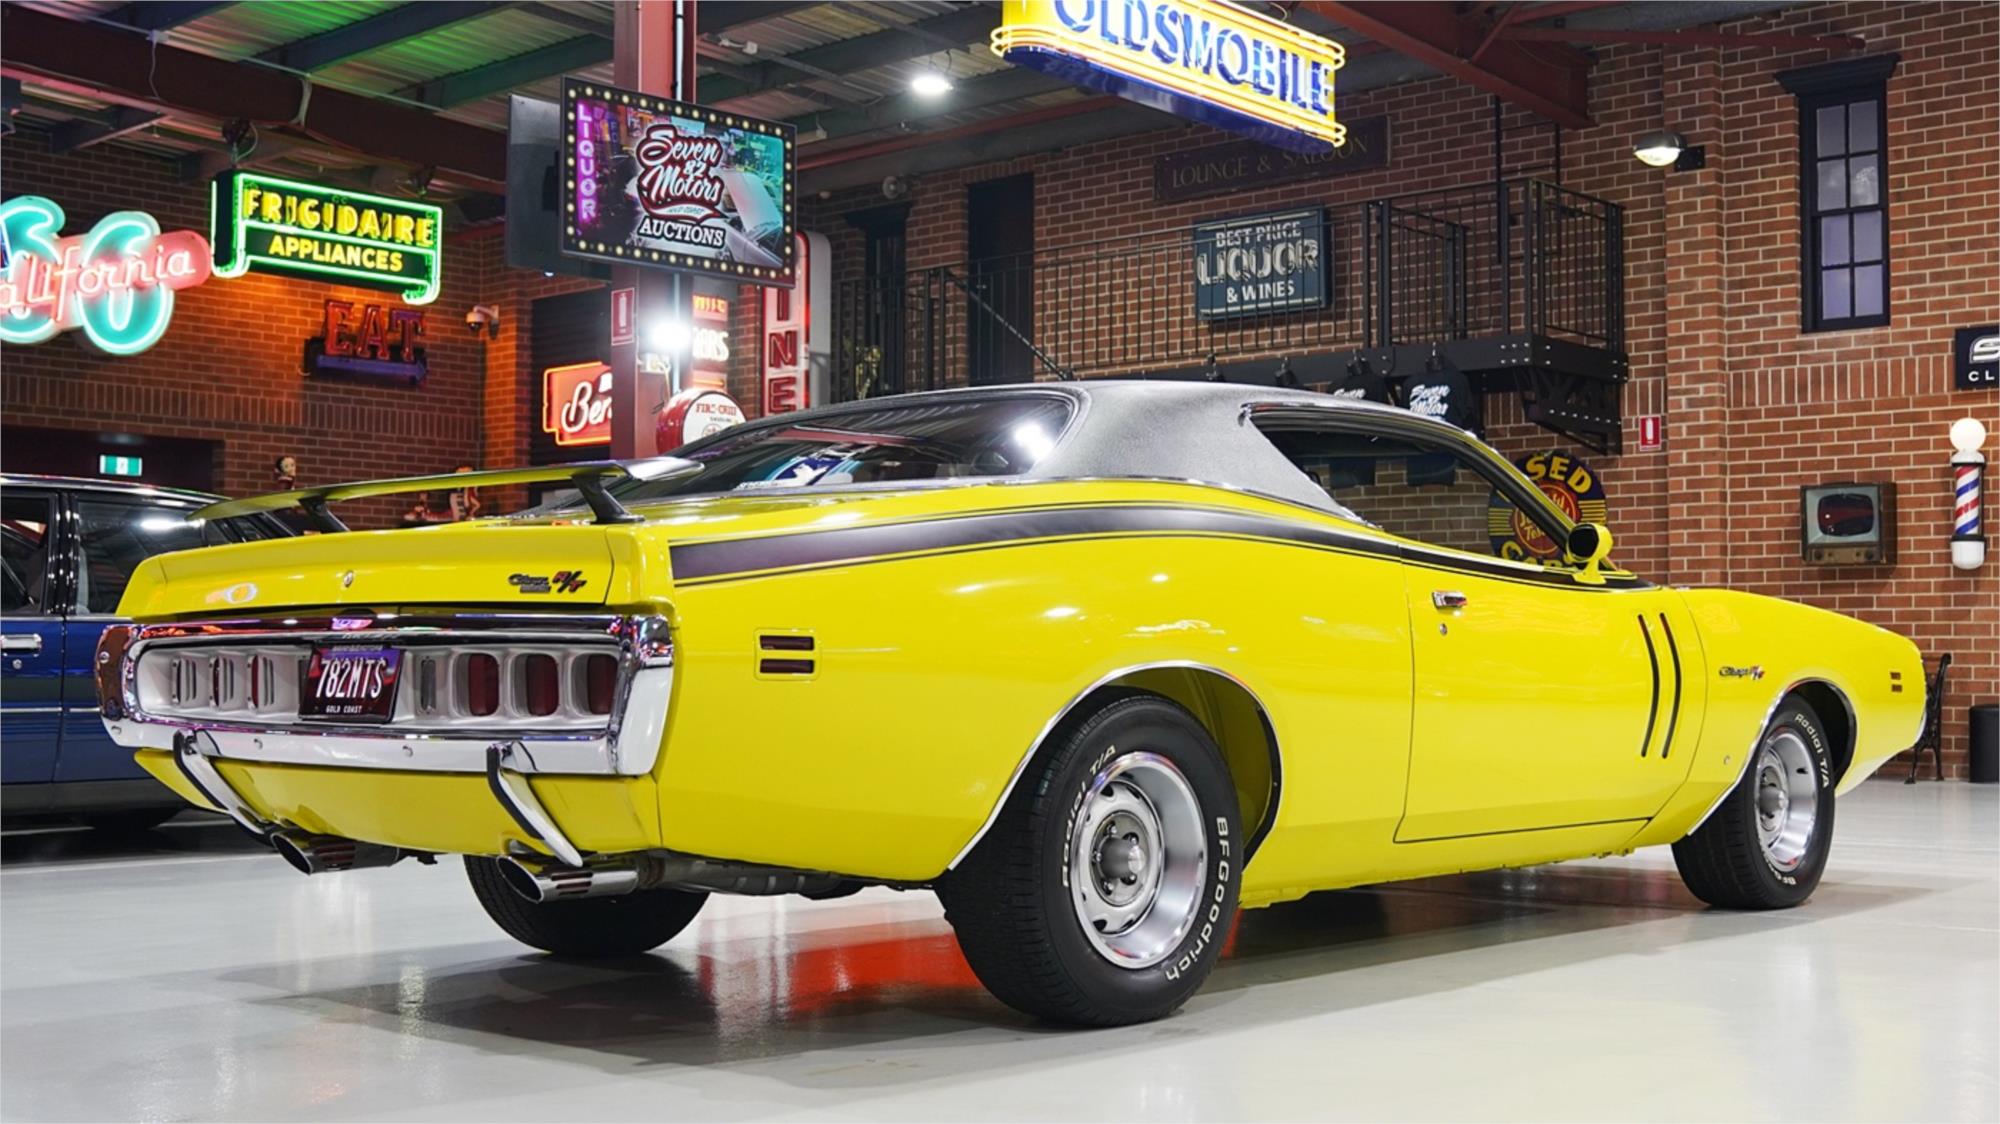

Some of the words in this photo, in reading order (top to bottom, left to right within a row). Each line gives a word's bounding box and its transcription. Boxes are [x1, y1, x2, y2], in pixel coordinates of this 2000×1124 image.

[1055, 0, 1333, 117] OLDSMOBILE
[577, 103, 597, 220] LIQUOR
[641, 126, 719, 167] Seven
[641, 164, 721, 203] Motors
[684, 162, 707, 176] 82
[1172, 156, 1249, 189] LOUNGE
[1257, 154, 1271, 174] &
[243, 188, 434, 247] FRIGIDAIRE
[639, 219, 724, 247] AUCTIONS
[1216, 228, 1253, 248] BEST
[1256, 221, 1301, 242] PRICE
[268, 235, 403, 272] APPLIANCES
[1197, 239, 1319, 286] LIQUOR
[0, 246, 196, 323] alifornia
[1226, 286, 1238, 304] &
[1241, 279, 1295, 301] WINES
[324, 300, 425, 363] EAT
[1968, 370, 1996, 382] CL
[1526, 456, 1592, 493] SED
[316, 656, 387, 698] 782MTS
[326, 705, 341, 714] GOLD
[343, 705, 362, 714] COAST
[1795, 713, 1824, 754] Radial
[1819, 757, 1831, 789] T/A
[1062, 780, 1086, 888] Radial
[1089, 744, 1117, 776] T/A
[1165, 816, 1230, 982] BFGoodrich
